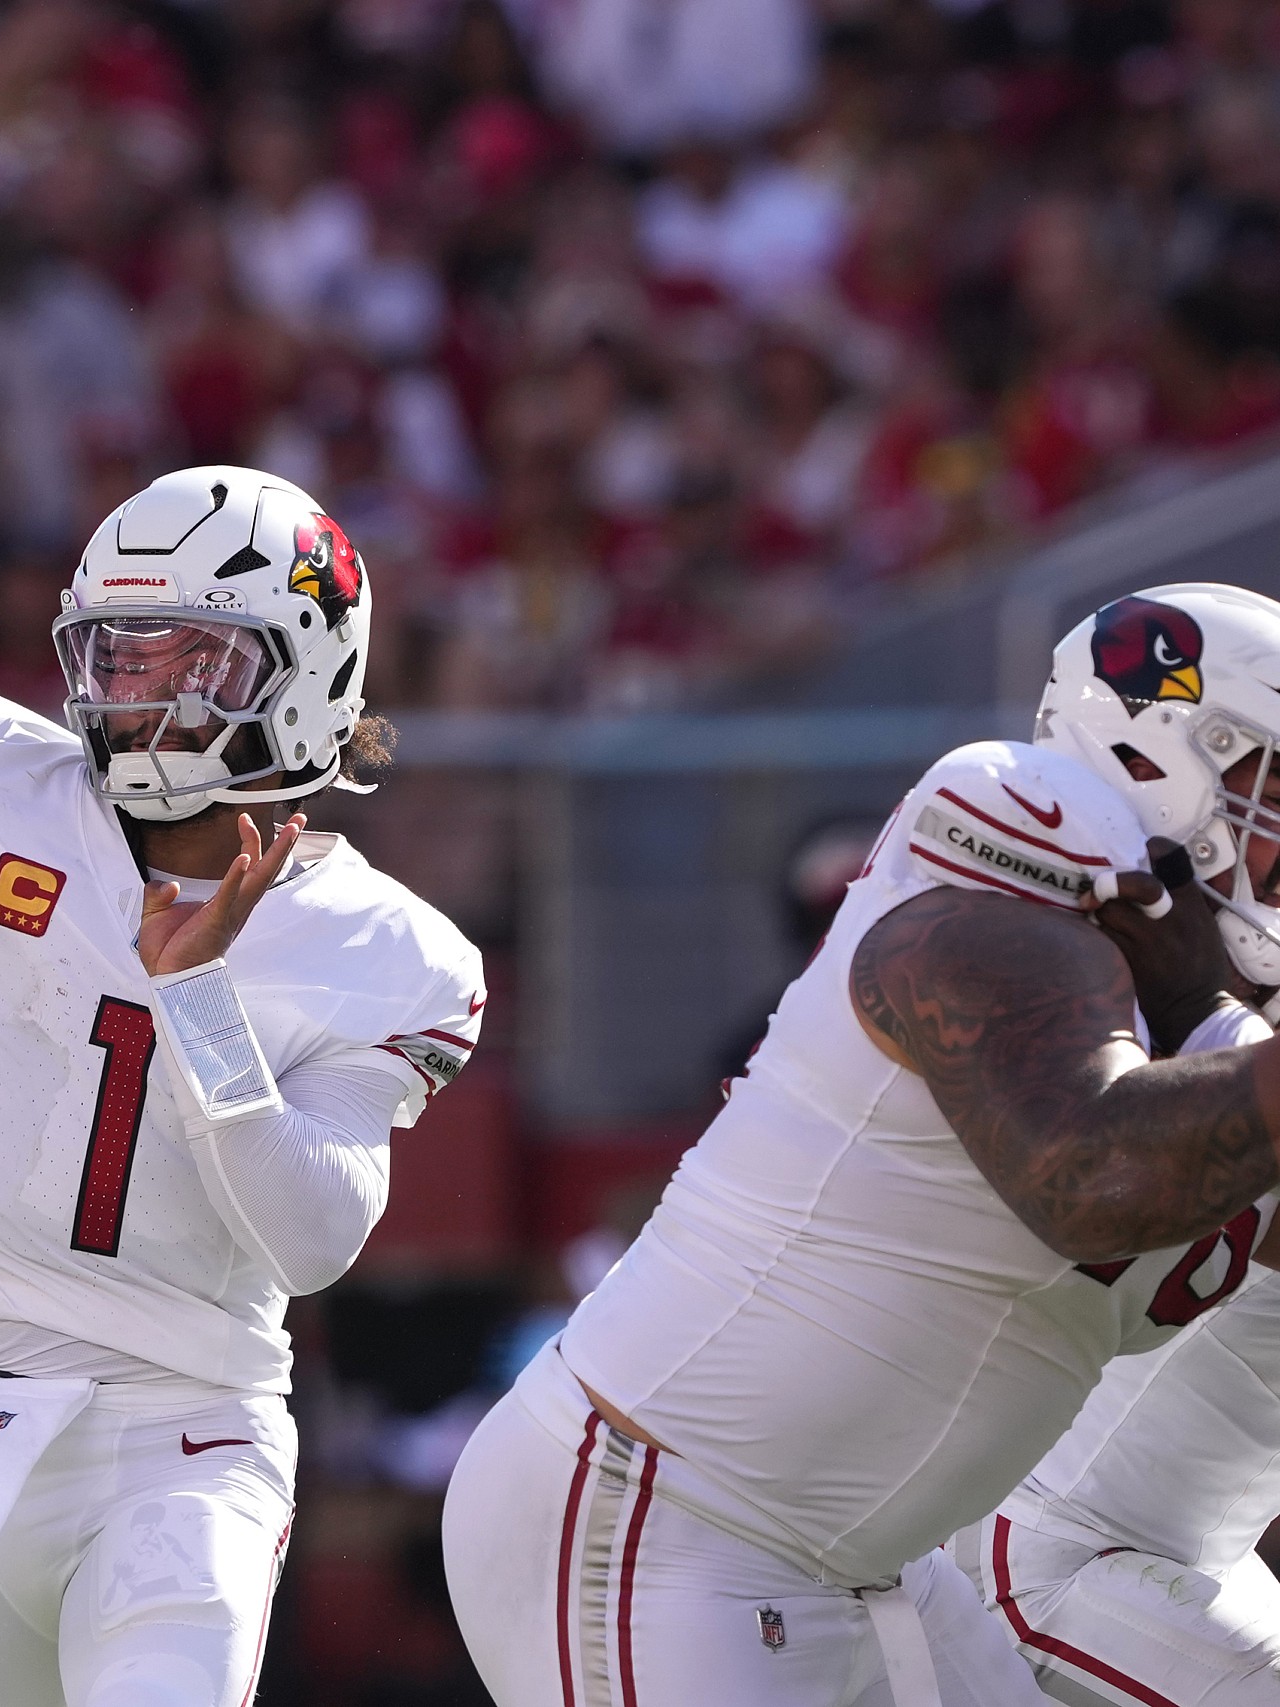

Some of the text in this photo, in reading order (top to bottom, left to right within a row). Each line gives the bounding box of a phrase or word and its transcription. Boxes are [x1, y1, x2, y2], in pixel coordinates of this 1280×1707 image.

[102, 578, 167, 587] CARDINALS
[197, 602, 243, 610] OAKLEY
[947, 826, 1094, 894] CARDINALS
[70, 994, 158, 1259] 1
[763, 1624, 784, 1643] NFL
